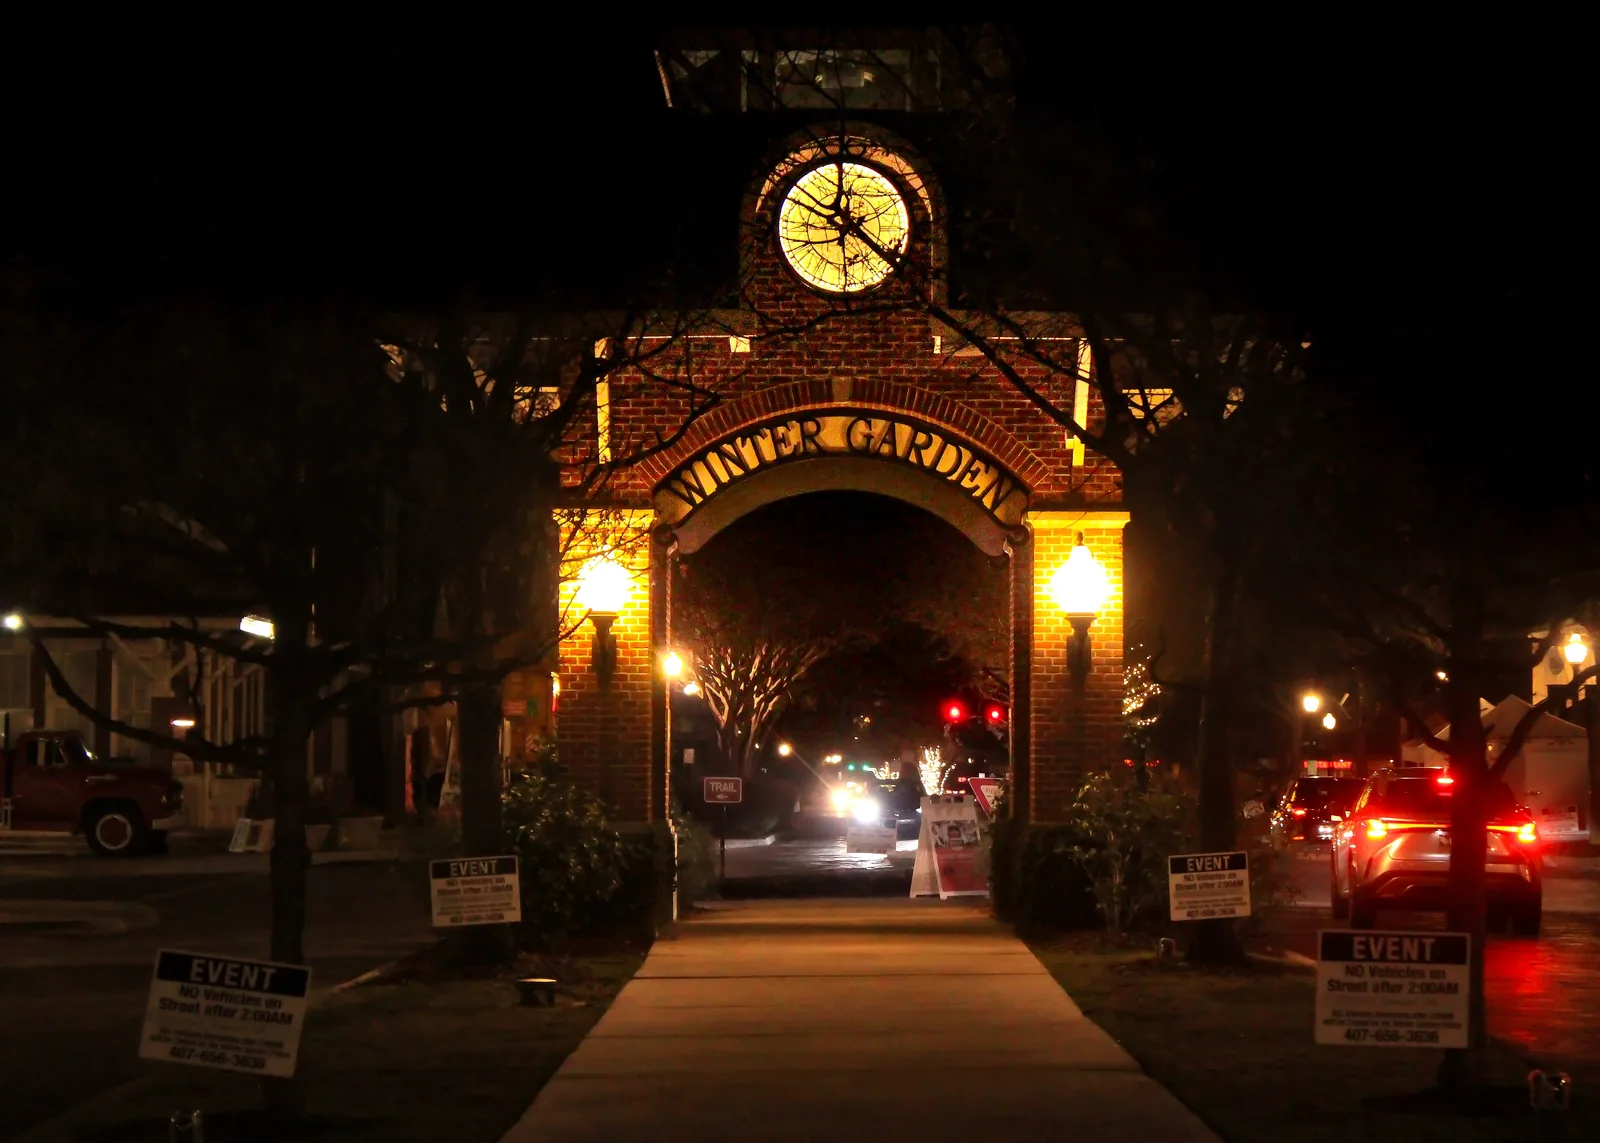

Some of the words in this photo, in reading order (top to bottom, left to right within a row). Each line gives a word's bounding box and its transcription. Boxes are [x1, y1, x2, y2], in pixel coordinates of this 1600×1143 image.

[667, 418, 822, 507] WINTER
[846, 418, 1017, 510] GARDEN
[710, 781, 737, 793] TRAIL
[450, 860, 497, 876] EVENT
[1188, 856, 1230, 871] EVENT
[1353, 935, 1436, 961] EVENT
[190, 958, 276, 991] EVENT
[1345, 964, 1364, 979] NO
[1369, 964, 1426, 979] Vehicles
[1429, 969, 1446, 980] on
[179, 984, 198, 999] NO
[204, 987, 261, 1007] Vehicles
[264, 998, 282, 1010] on
[1327, 978, 1368, 993] Street
[1372, 980, 1404, 994] after
[1408, 981, 1459, 995] 2:00AM
[158, 996, 200, 1014] Street
[204, 1003, 238, 1019] after
[241, 1007, 293, 1026] 2:00AM
